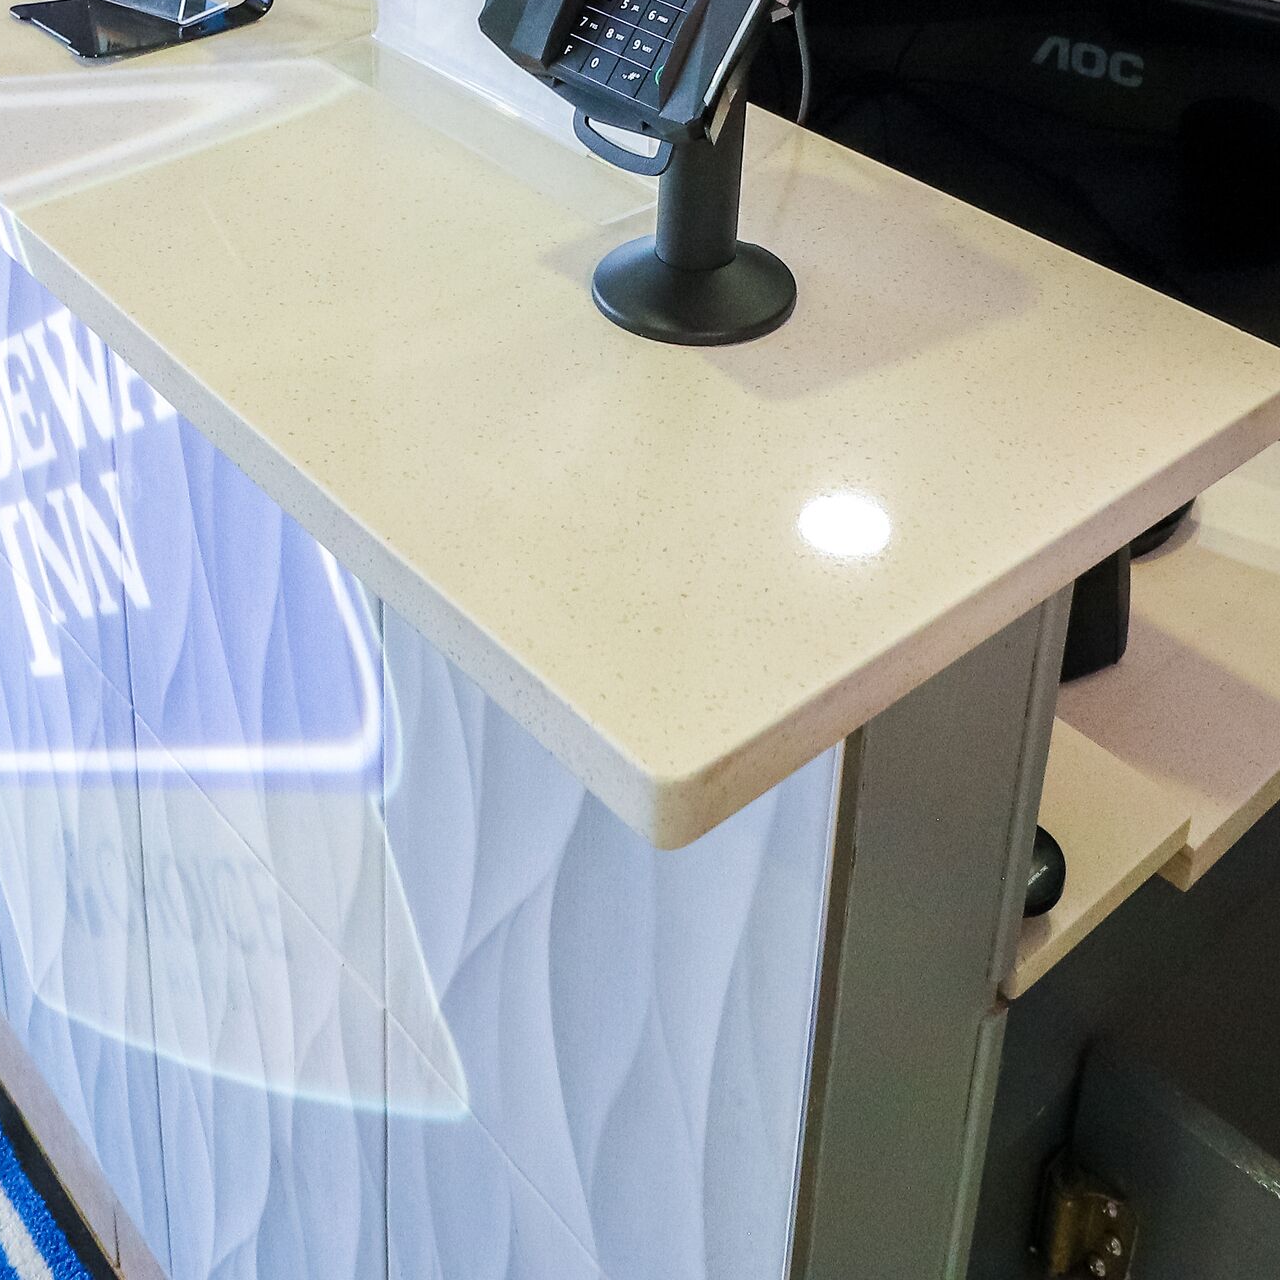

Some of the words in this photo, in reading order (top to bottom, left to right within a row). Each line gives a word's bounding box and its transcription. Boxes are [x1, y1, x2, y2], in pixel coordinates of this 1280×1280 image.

[620, 0, 630, 9] 5
[647, 10, 657, 21] 6
[579, 16, 588, 27] 7
[605, 28, 615, 39] 8
[632, 39, 642, 50] 9
[564, 45, 573, 55] F
[590, 57, 600, 68] 0
[1031, 35, 1144, 88] AOC
